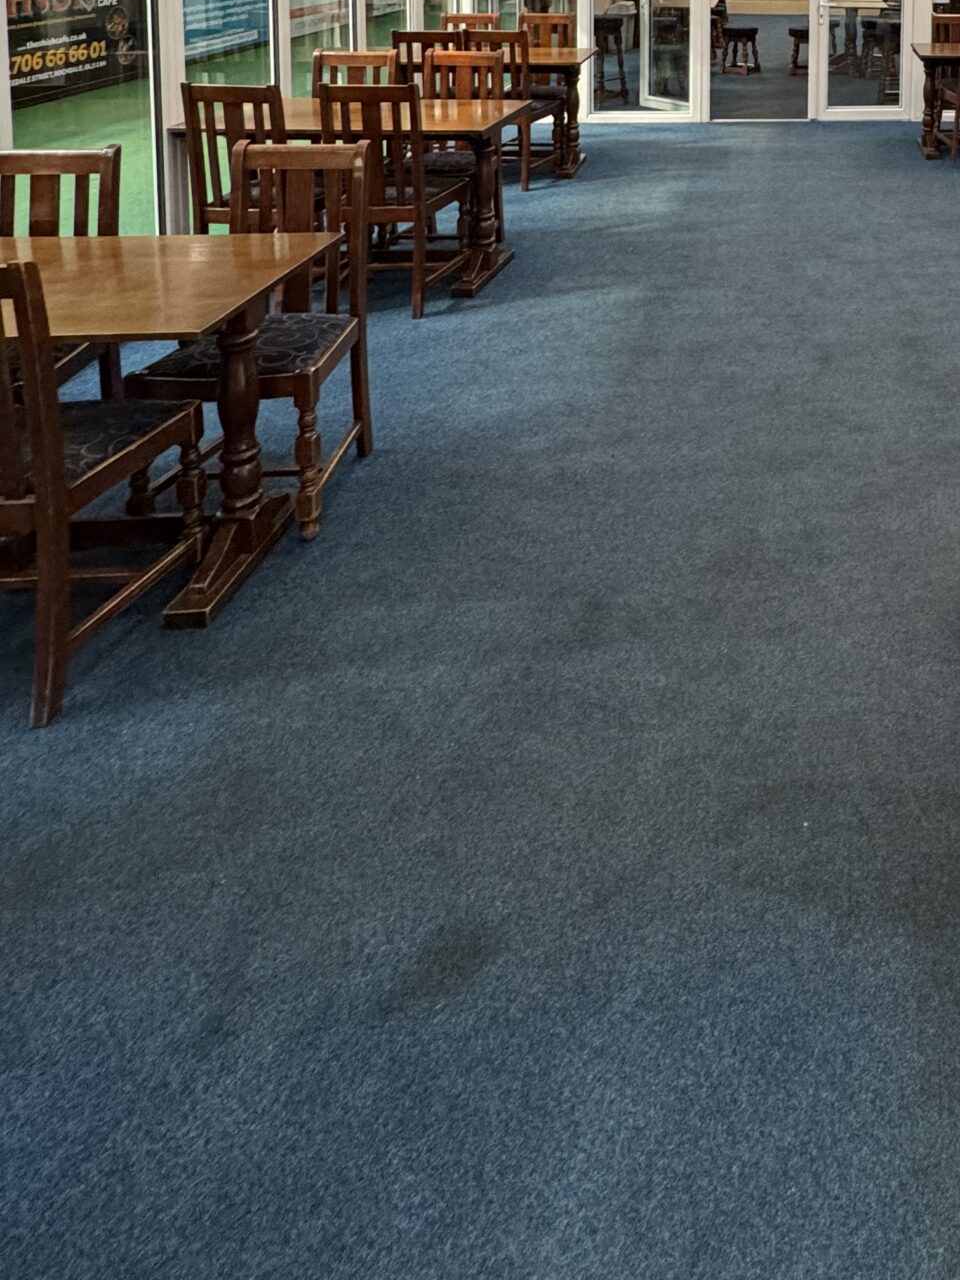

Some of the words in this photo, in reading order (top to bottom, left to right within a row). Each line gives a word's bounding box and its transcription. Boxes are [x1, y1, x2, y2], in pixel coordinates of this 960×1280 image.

[45, 47, 66, 68] 66
[68, 42, 88, 63] 66
[89, 39, 108, 59] 01
